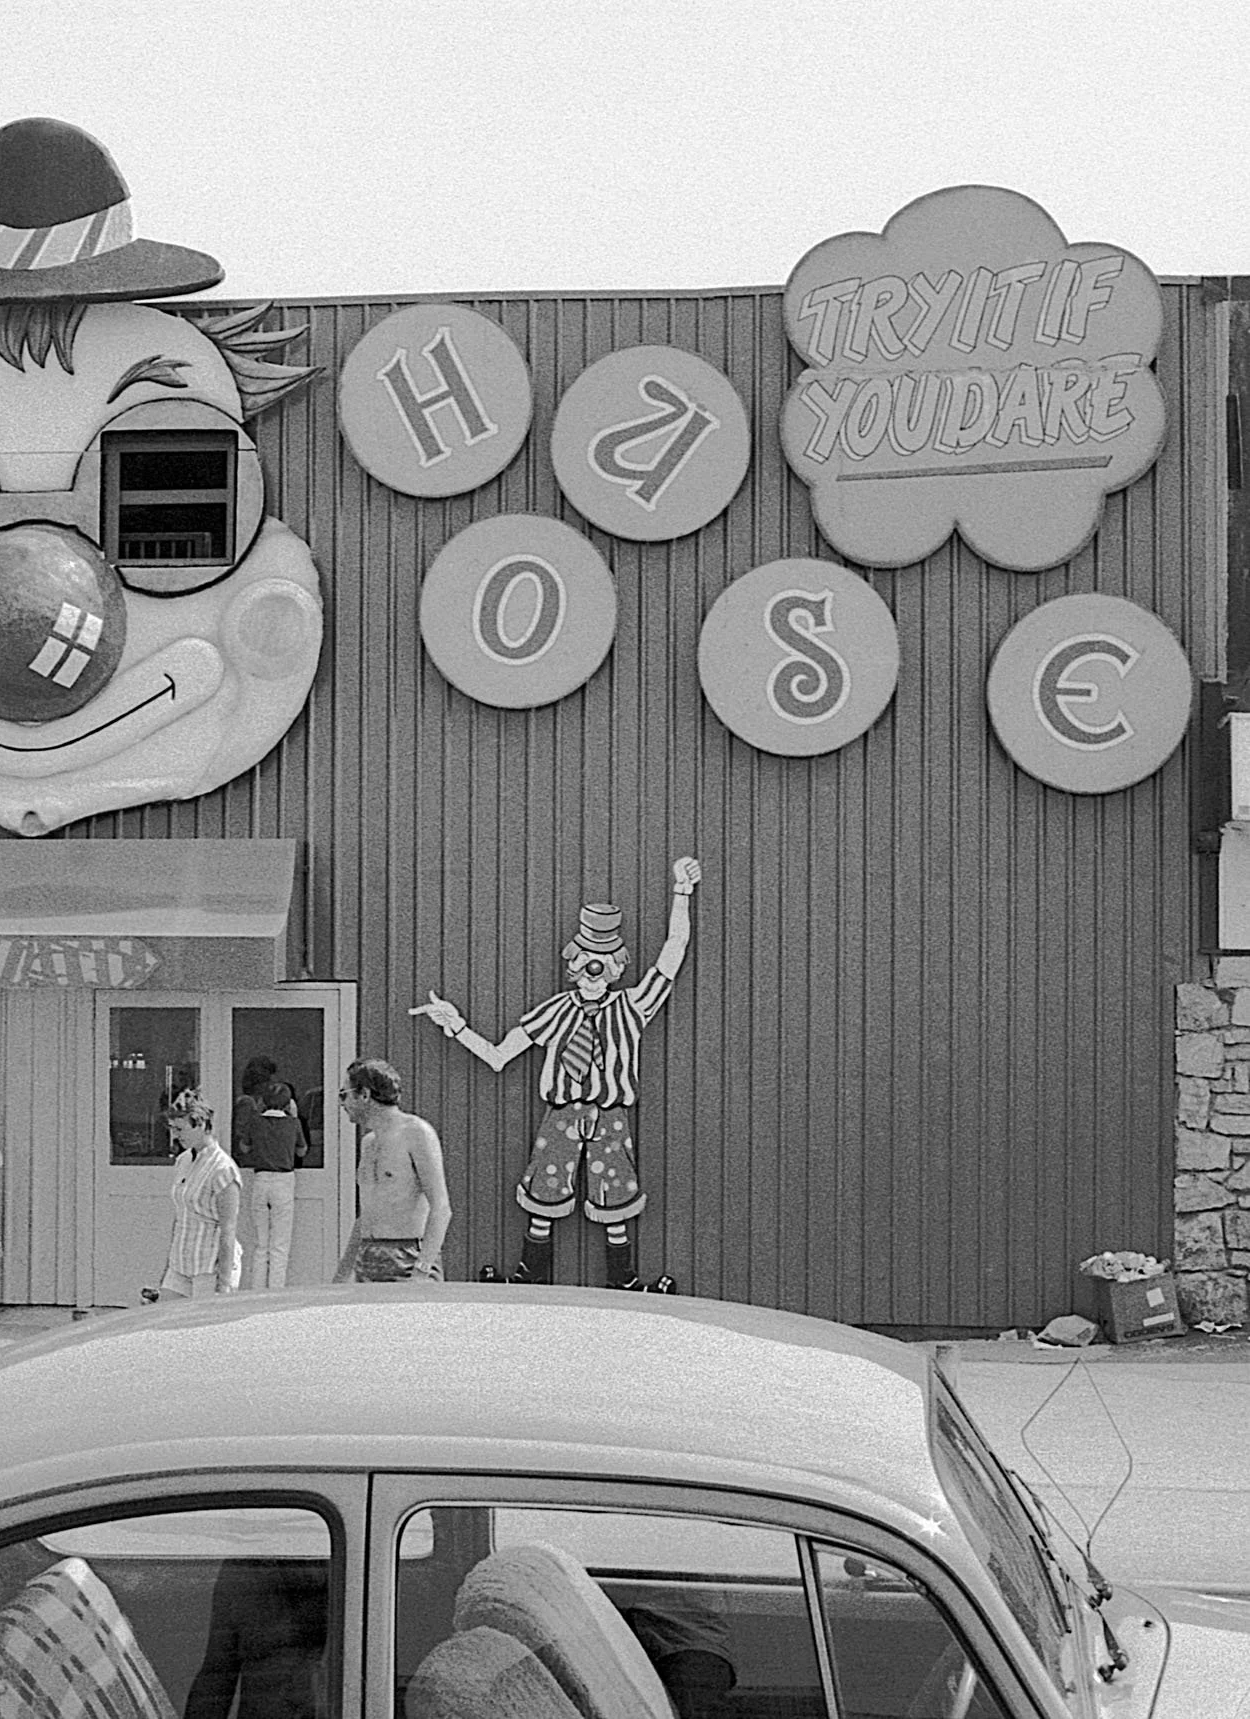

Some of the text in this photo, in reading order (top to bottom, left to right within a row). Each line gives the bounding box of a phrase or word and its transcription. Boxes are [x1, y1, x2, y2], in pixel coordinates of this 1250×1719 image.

[798, 255, 1125, 366] TRY IT IF
[799, 352, 1143, 464] YOU DARE
